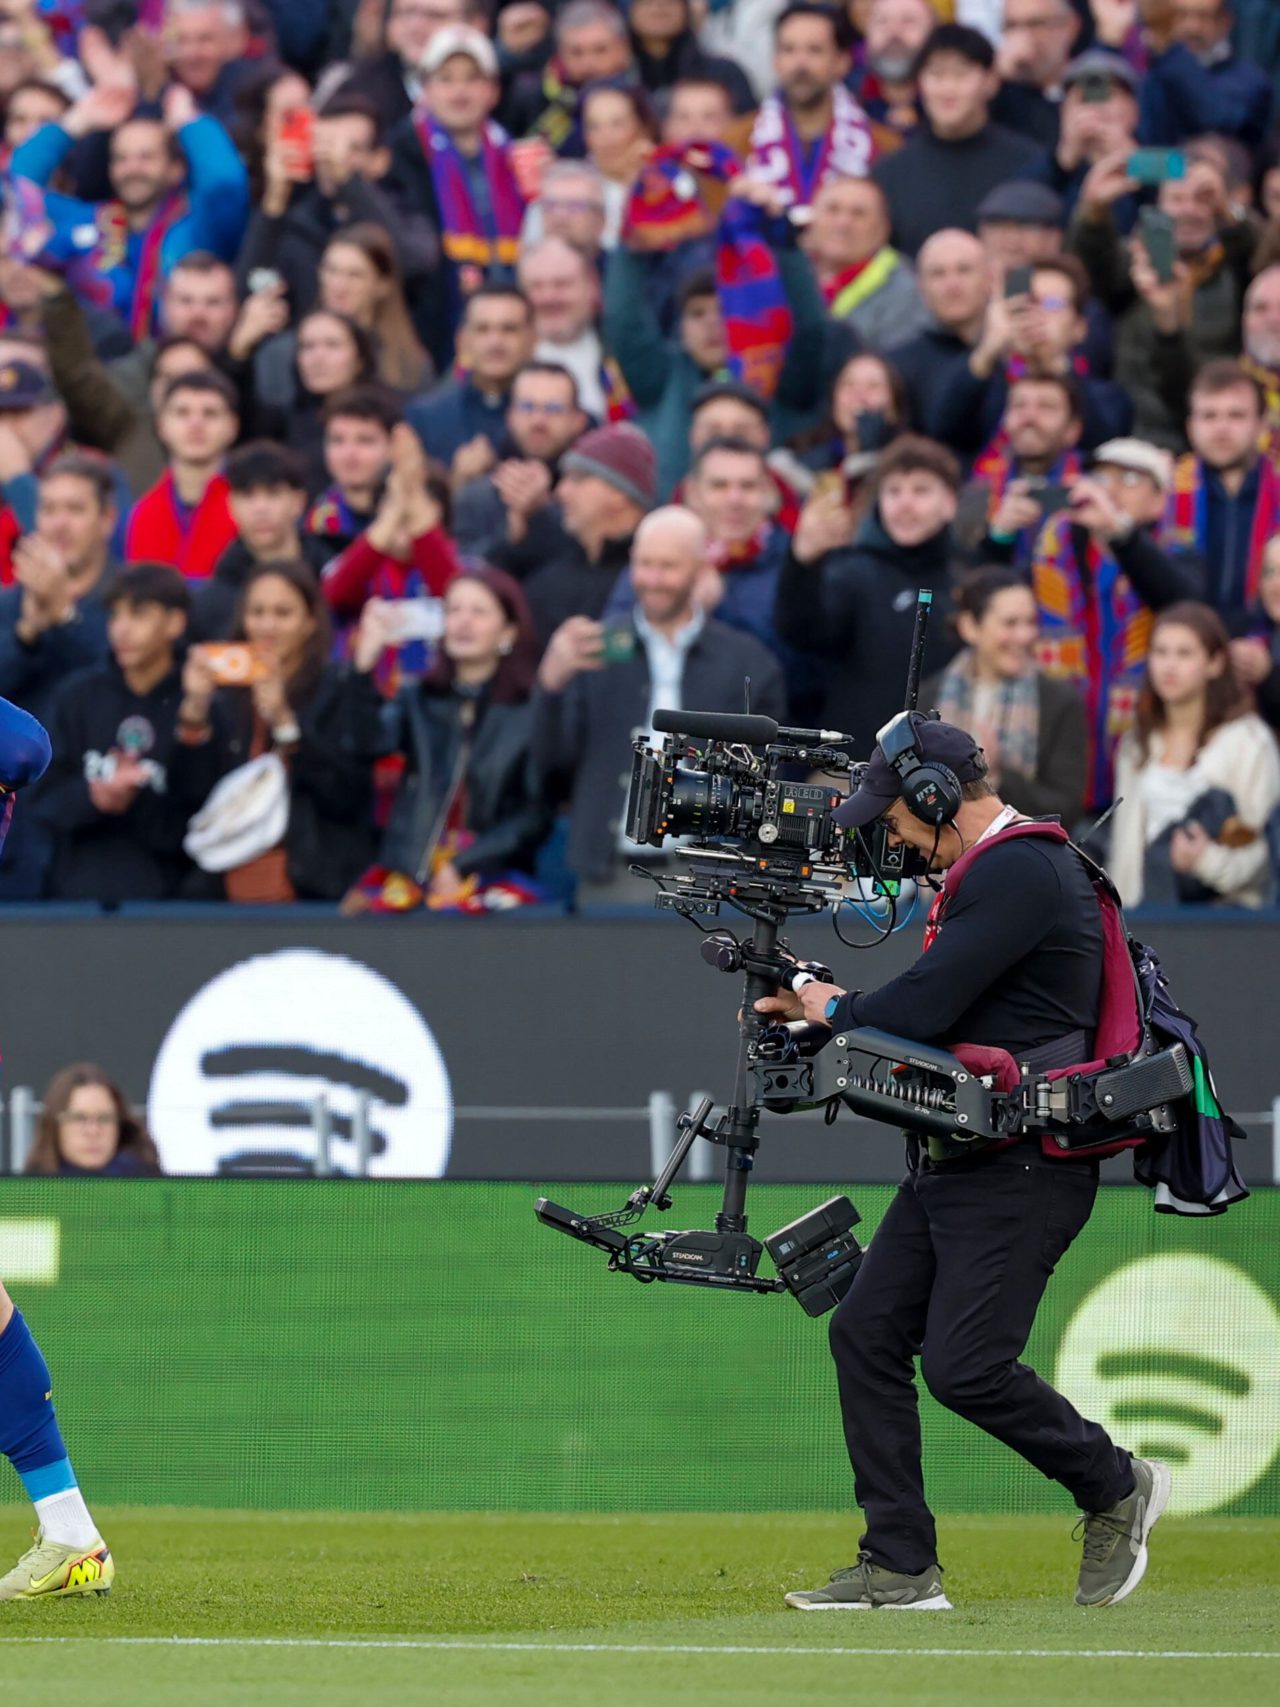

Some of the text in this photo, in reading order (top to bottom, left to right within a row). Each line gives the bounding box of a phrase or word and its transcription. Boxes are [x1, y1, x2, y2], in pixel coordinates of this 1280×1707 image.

[784, 785, 824, 800] RED
[916, 783, 937, 802] RTS
[908, 1057, 938, 1071] STEADICAM
[672, 1251, 704, 1261] STEADICAM
